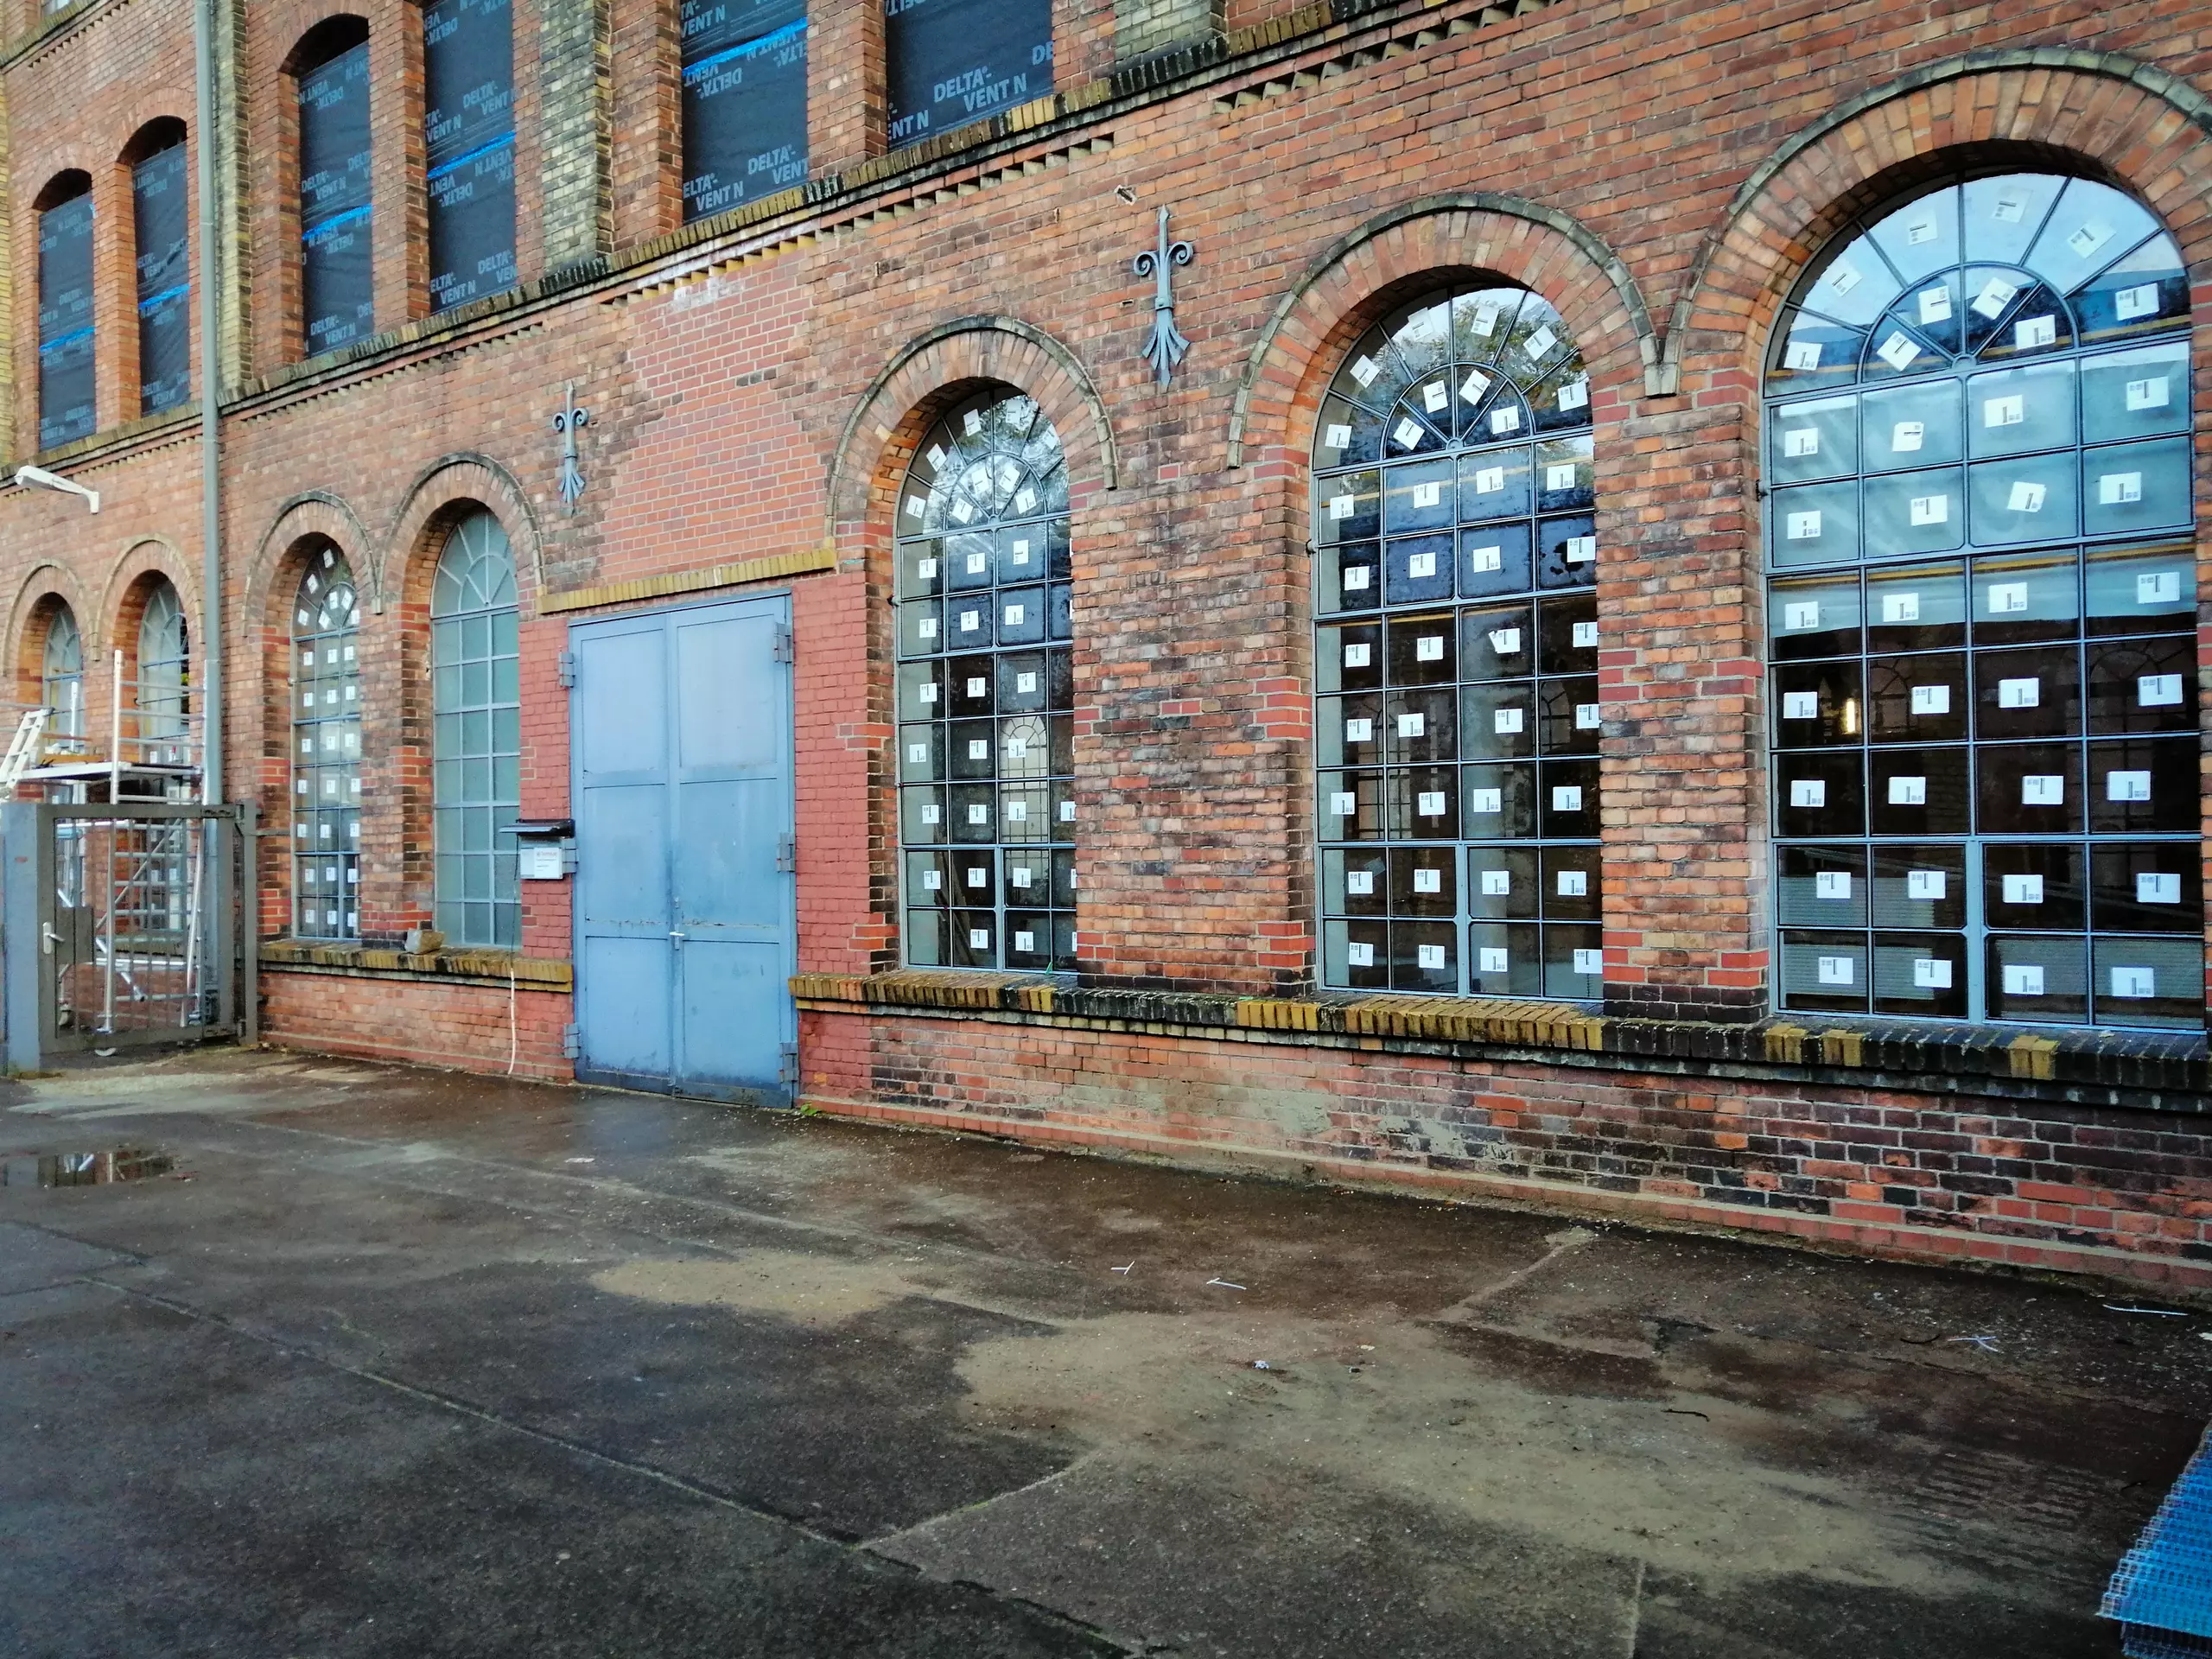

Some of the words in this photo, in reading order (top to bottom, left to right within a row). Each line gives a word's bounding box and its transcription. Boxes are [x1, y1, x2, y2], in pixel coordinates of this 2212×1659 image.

[715, 4, 726, 23] N
[759, 25, 797, 56] VENT
[684, 64, 719, 87] VENT
[307, 79, 329, 105] VENT
[480, 91, 508, 116] VENT
[963, 79, 1009, 112] VENT
[1013, 73, 1027, 94] N
[427, 119, 452, 143] VENT
[453, 113, 461, 130] N
[917, 109, 930, 130] N
[474, 162, 483, 177] N
[485, 148, 512, 173] VENT
[315, 181, 338, 200] VENT
[339, 176, 346, 191] N
[696, 186, 731, 212] VENT
[734, 181, 744, 200] N
[440, 283, 466, 305] VENT
[467, 279, 477, 295] N
[325, 327, 346, 346] VENT
[348, 322, 356, 337] N
